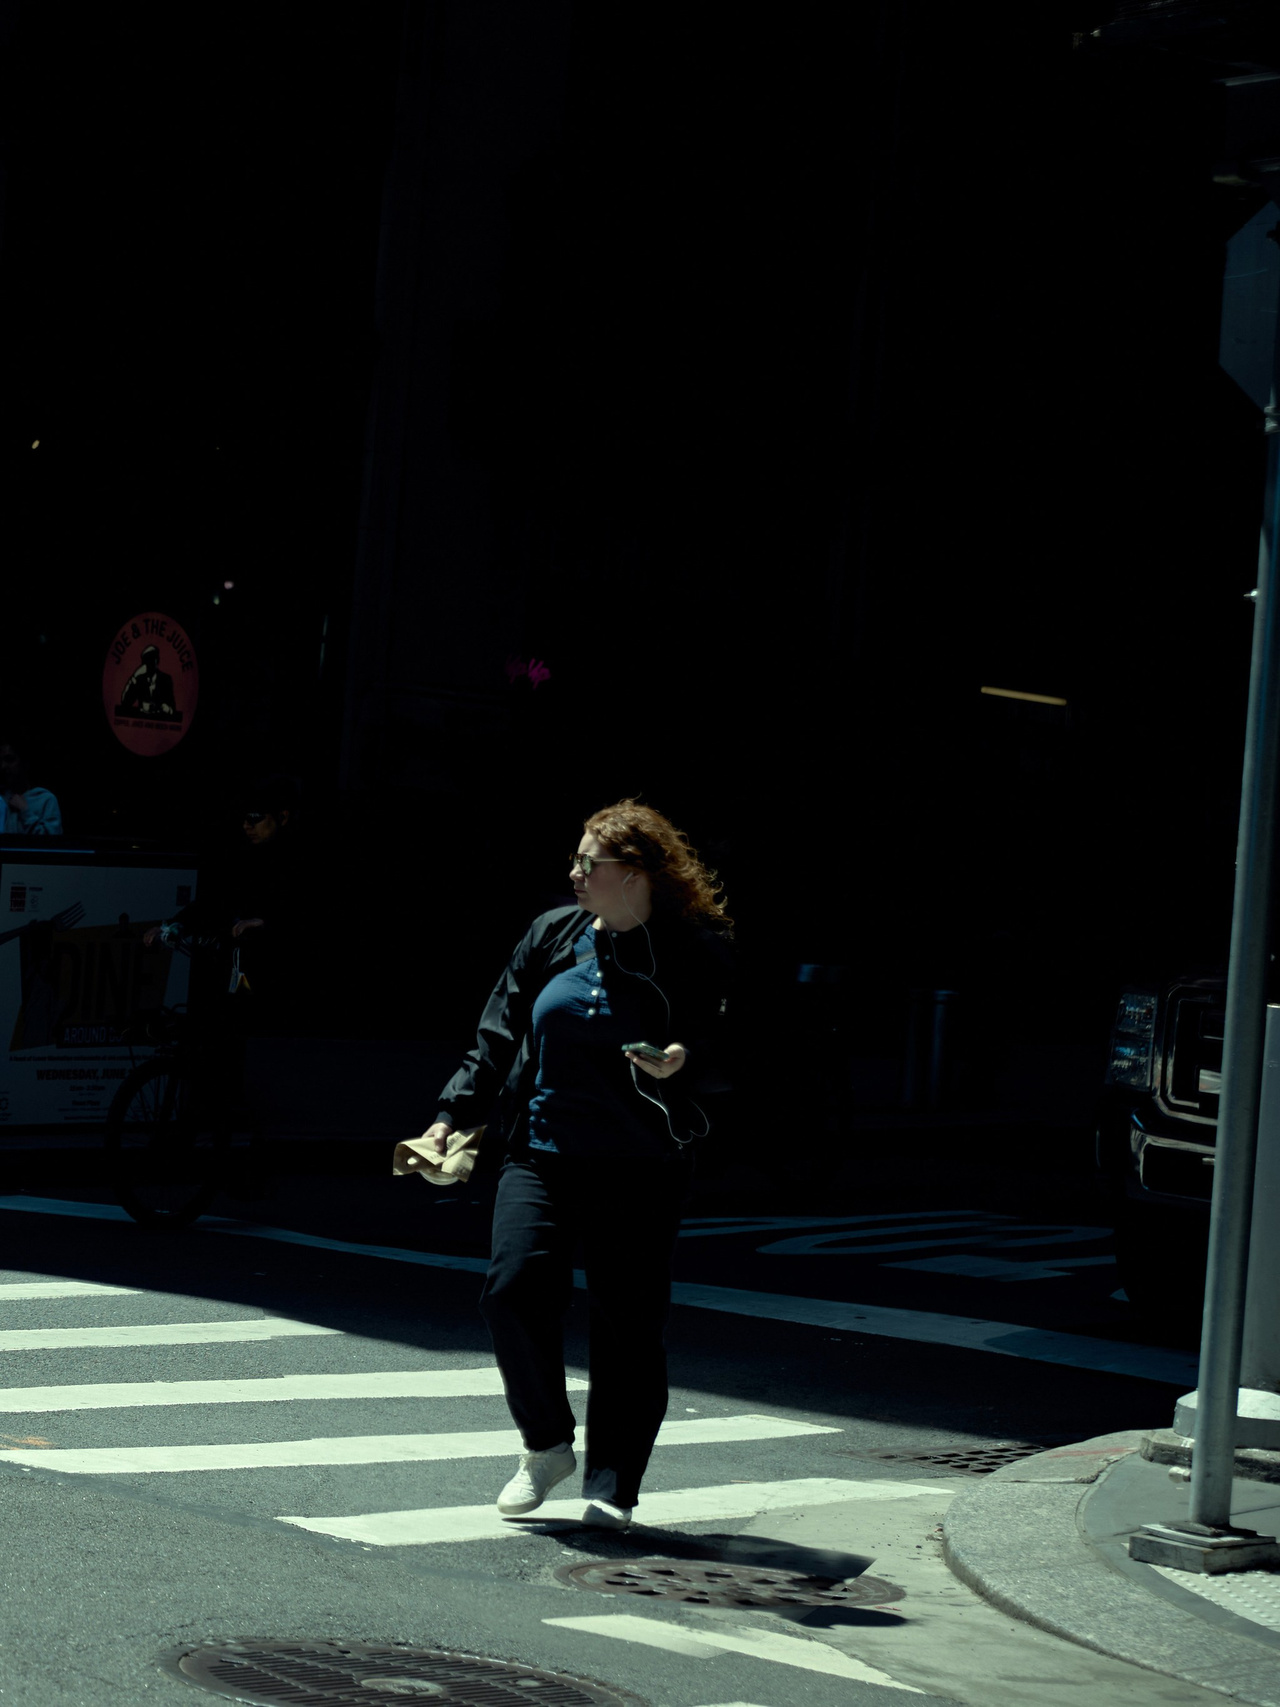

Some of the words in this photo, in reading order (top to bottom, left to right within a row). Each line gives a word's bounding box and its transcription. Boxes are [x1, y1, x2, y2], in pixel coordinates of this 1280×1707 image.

[111, 631, 132, 665] JOE
[131, 622, 142, 640] &
[143, 618, 168, 638] THE
[166, 630, 195, 673] JUICE
[62, 1026, 107, 1044] AROUND
[36, 1069, 99, 1081] WEDNESDAY,
[101, 1068, 126, 1080] JUNE
